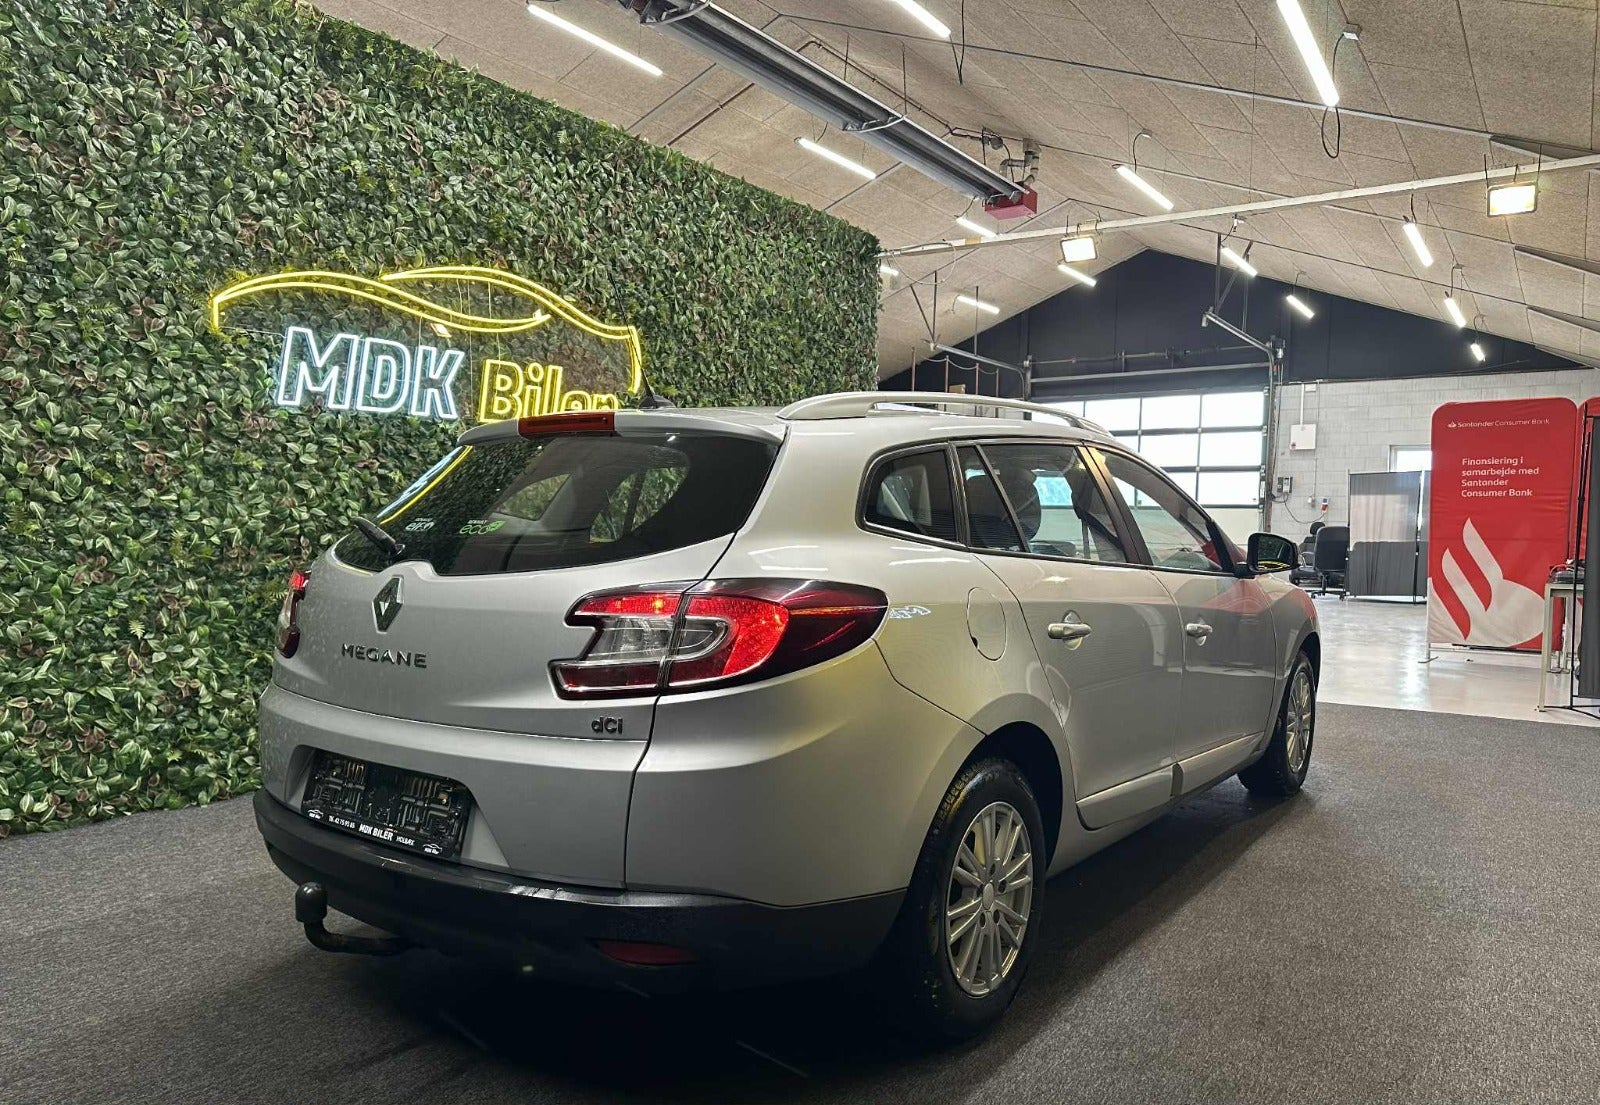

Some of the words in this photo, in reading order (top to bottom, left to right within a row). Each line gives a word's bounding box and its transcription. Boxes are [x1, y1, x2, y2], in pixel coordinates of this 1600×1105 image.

[277, 326, 465, 420] MDK
[1494, 419, 1530, 427] Consumer
[1462, 457, 1518, 466] Finansiering
[1461, 468, 1517, 477] samarbejde
[1518, 467, 1539, 475] med
[1461, 479, 1509, 487] Santander
[1461, 489, 1507, 498] Consumer
[1508, 489, 1533, 497] Bank
[341, 643, 427, 669] MEGANE
[591, 716, 623, 734] dCi
[358, 823, 374, 835] MDK
[372, 827, 394, 841] BILER
